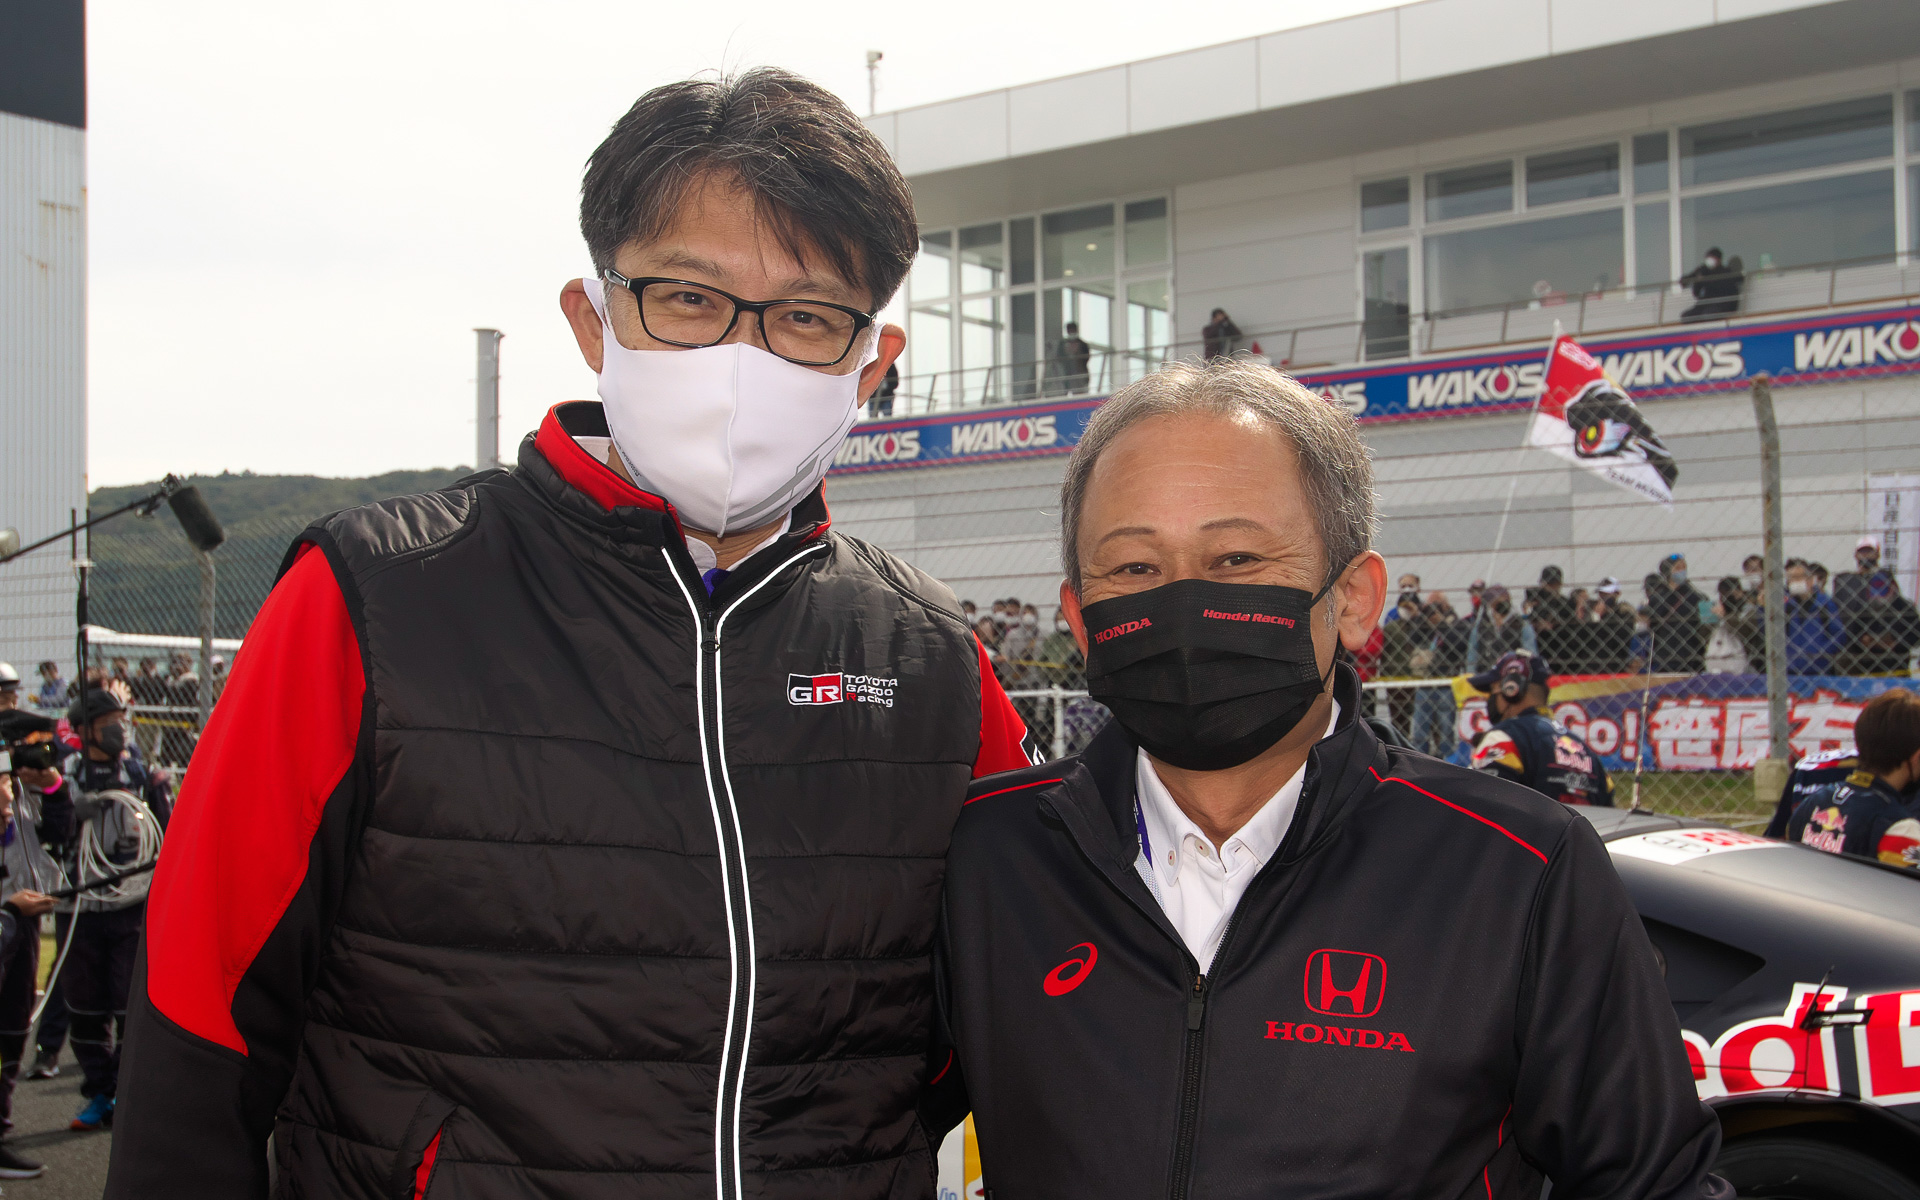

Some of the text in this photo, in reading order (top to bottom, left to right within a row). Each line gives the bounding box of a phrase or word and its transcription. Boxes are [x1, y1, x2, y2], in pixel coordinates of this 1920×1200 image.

[1794, 320, 1920, 371] WAKO
[1408, 362, 1547, 410] WAKO'S
[951, 415, 1058, 455] WAKO'S
[1094, 617, 1153, 645] HONDA
[1203, 609, 1296, 629] Honda Racing
[844, 674, 898, 687] TOYOTA
[846, 684, 894, 696] GAZOO
[790, 685, 840, 702] GR
[846, 692, 894, 708] Racing
[1264, 1020, 1415, 1052] HONDA
